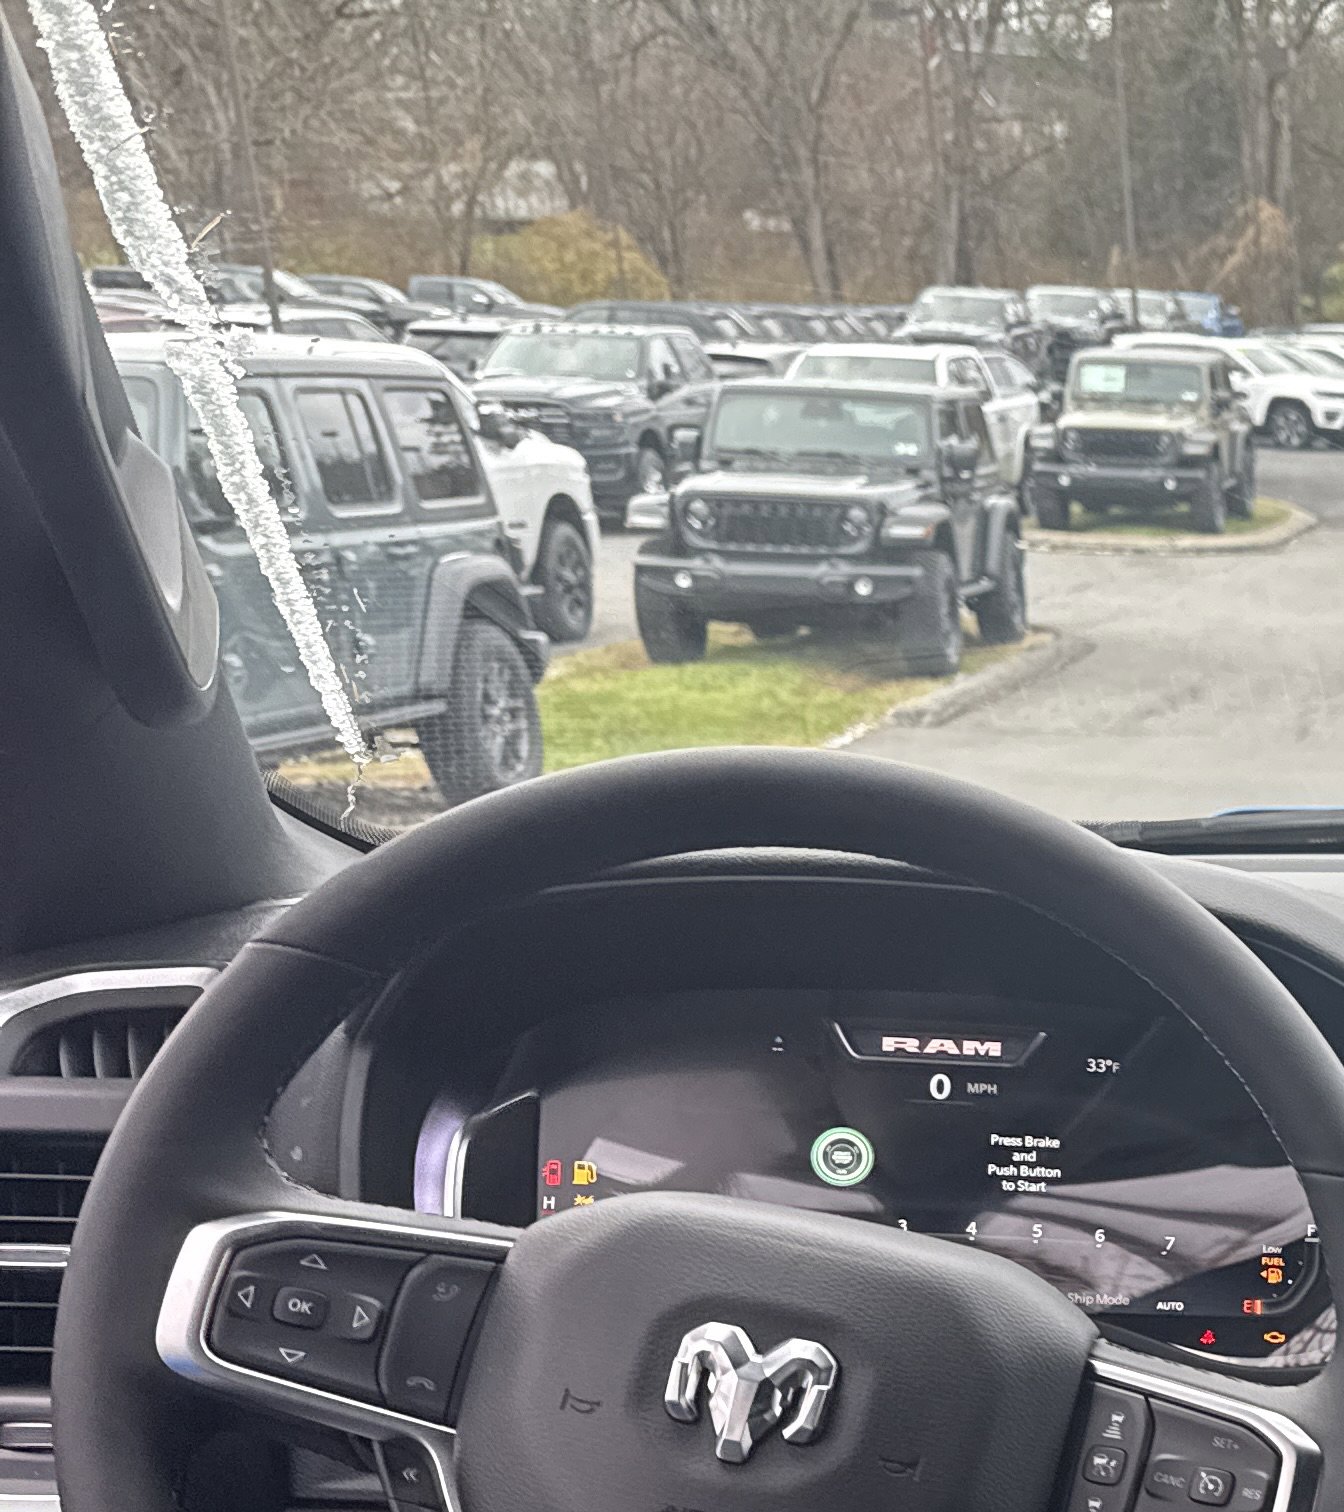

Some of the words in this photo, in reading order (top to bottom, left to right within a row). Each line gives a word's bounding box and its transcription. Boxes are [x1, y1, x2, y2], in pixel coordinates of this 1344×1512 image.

[881, 1036, 1002, 1057] RAM
[929, 1073, 952, 1100] 0
[966, 1081, 999, 1095] MPH
[990, 1133, 1023, 1147] Press
[1024, 1135, 1061, 1149] Brake
[1011, 1150, 1037, 1162] and
[987, 1163, 1018, 1176] Push
[1019, 1164, 1062, 1178] Button
[1001, 1180, 1015, 1191] to
[1016, 1180, 1047, 1193] Start
[542, 1195, 556, 1210] H
[965, 1221, 978, 1236] 4
[1031, 1223, 1043, 1239] 5
[1094, 1228, 1106, 1244] 6
[1307, 1224, 1318, 1237] F
[1163, 1236, 1176, 1250] 7
[1261, 1256, 1286, 1267] FUEL
[287, 1297, 316, 1315] OK
[1067, 1292, 1094, 1307] Ship
[1095, 1292, 1131, 1306] Mode
[1155, 1301, 1185, 1312] AUTO
[1243, 1299, 1253, 1313] E
[1241, 1487, 1263, 1500] RES
